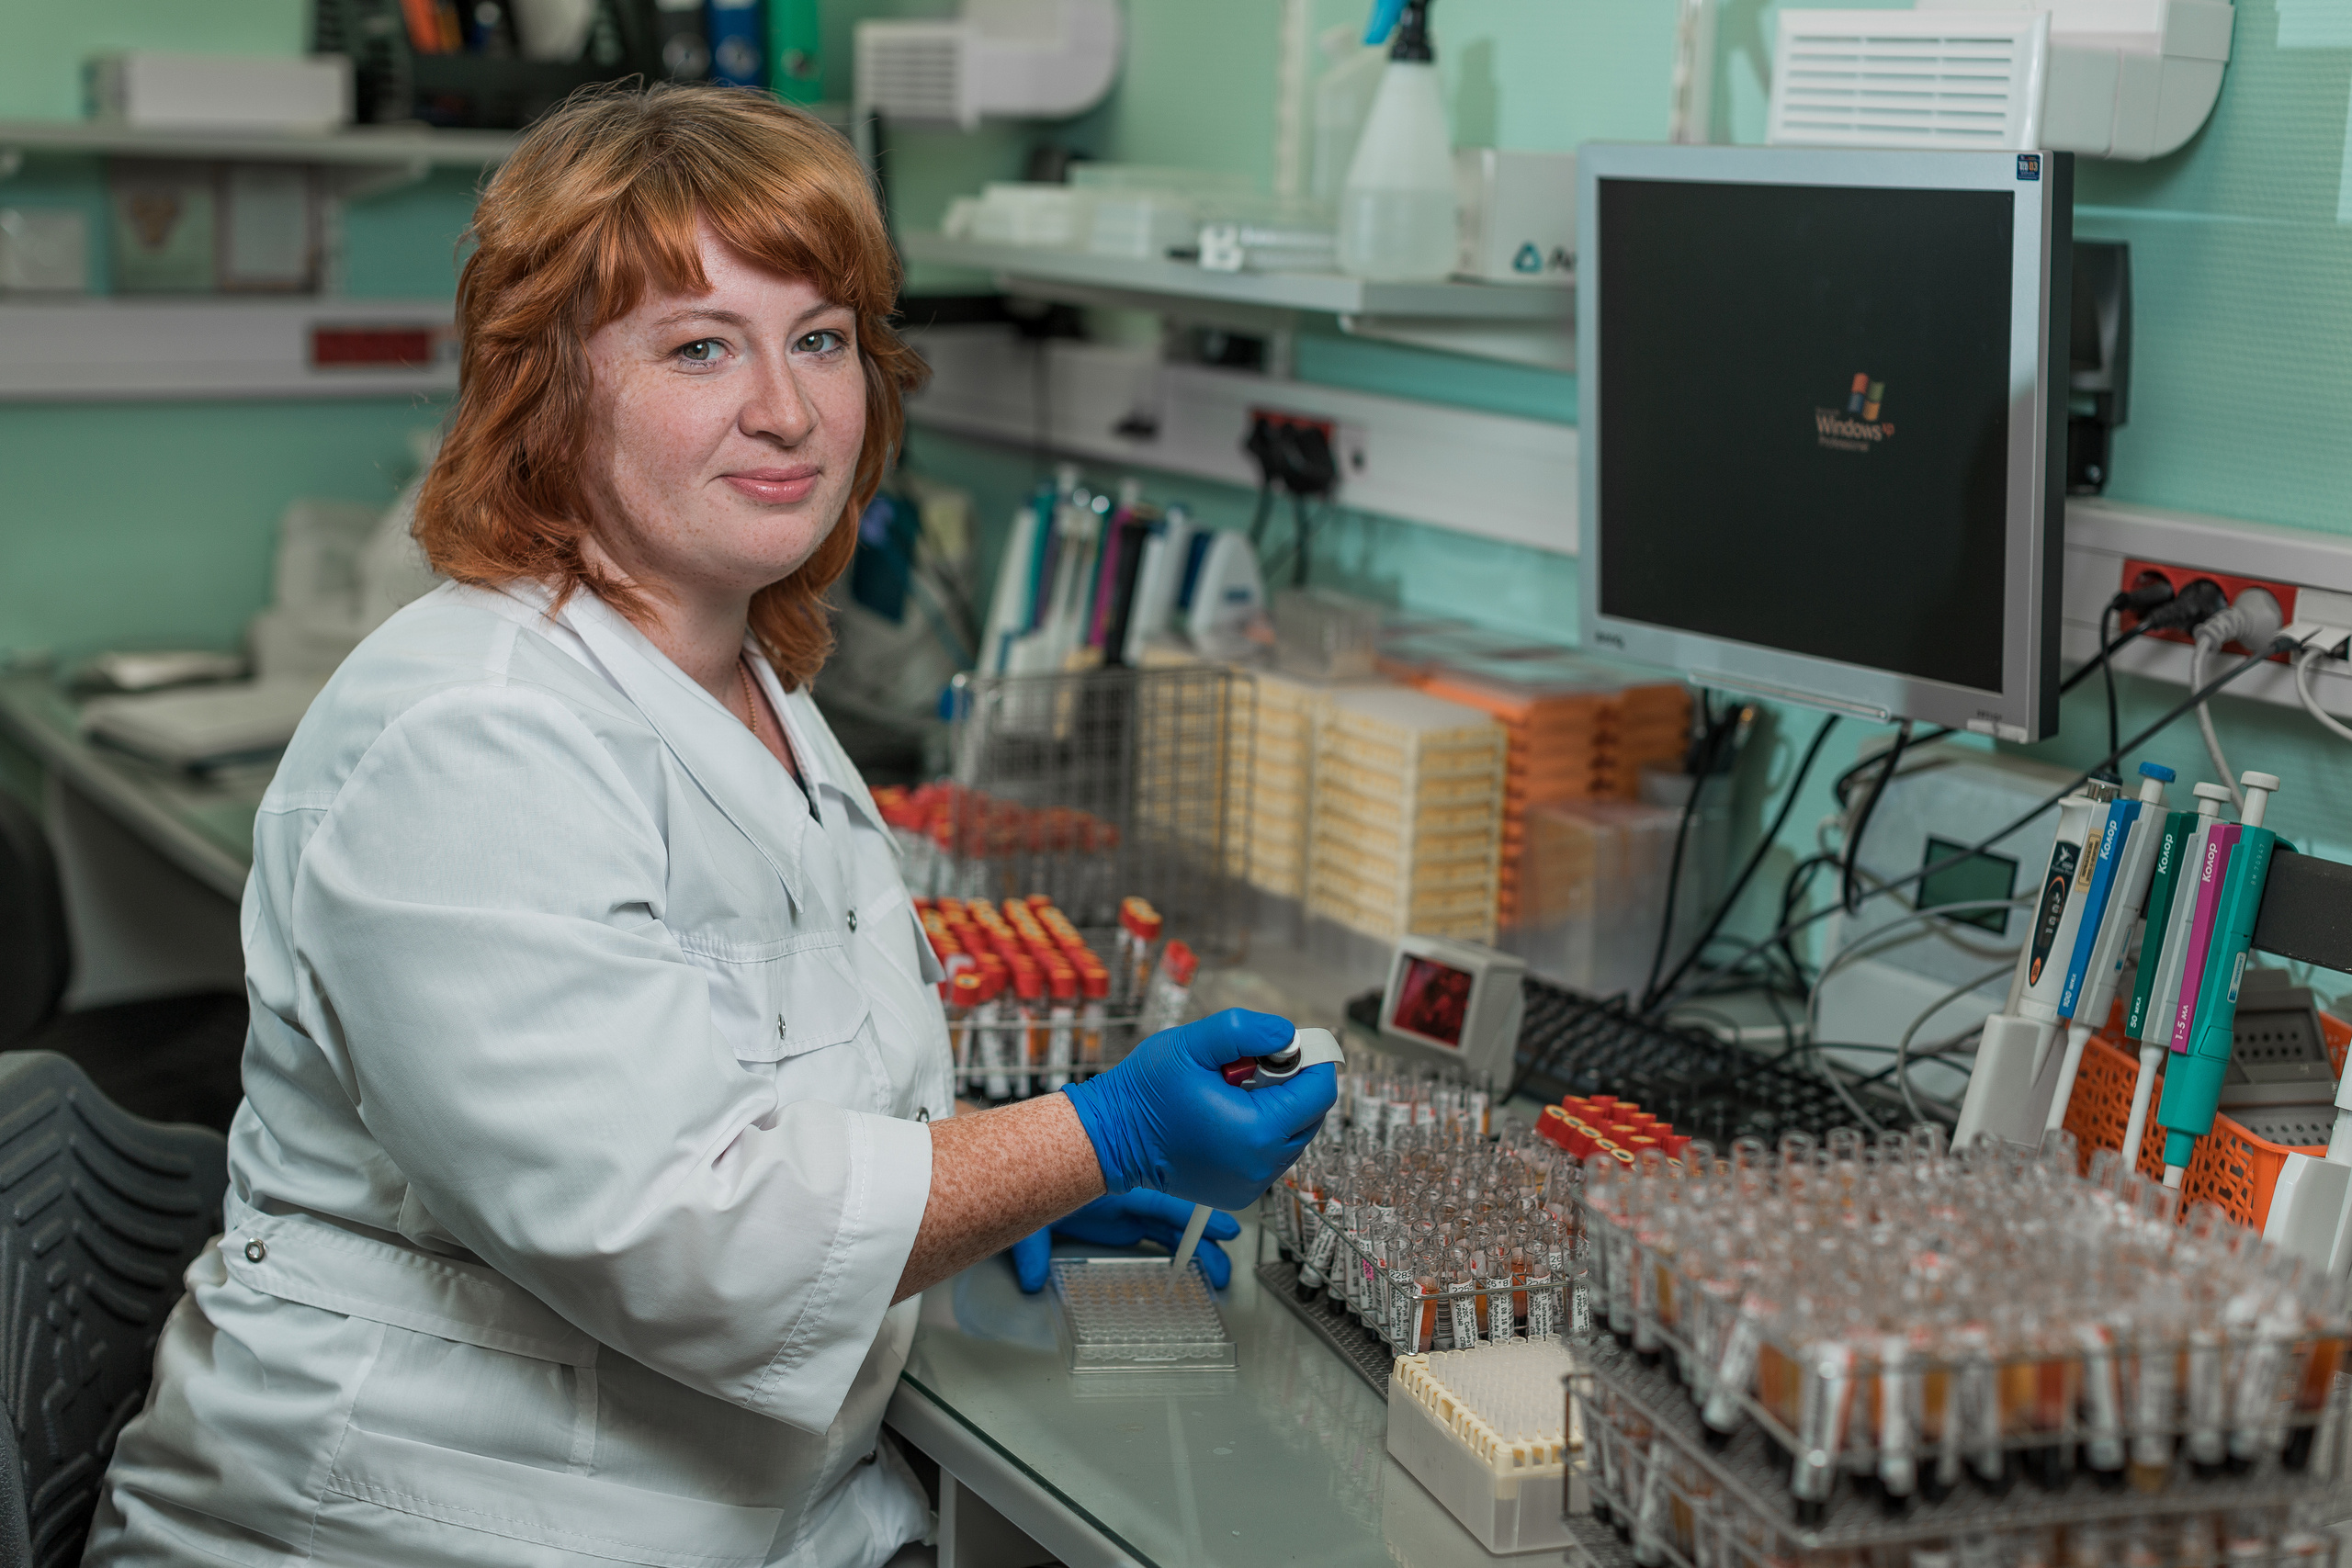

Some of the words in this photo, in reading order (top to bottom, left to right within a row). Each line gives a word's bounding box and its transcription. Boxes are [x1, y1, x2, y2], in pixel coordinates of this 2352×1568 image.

[1816, 415, 1883, 441] Windows
[2098, 819, 2118, 861] Колор
[2157, 833, 2174, 875] Колор
[2201, 842, 2217, 883] Колор
[2062, 990, 2073, 1009] 100
[2129, 1014, 2139, 1029] 50
[2175, 1021, 2187, 1041] 1-5
